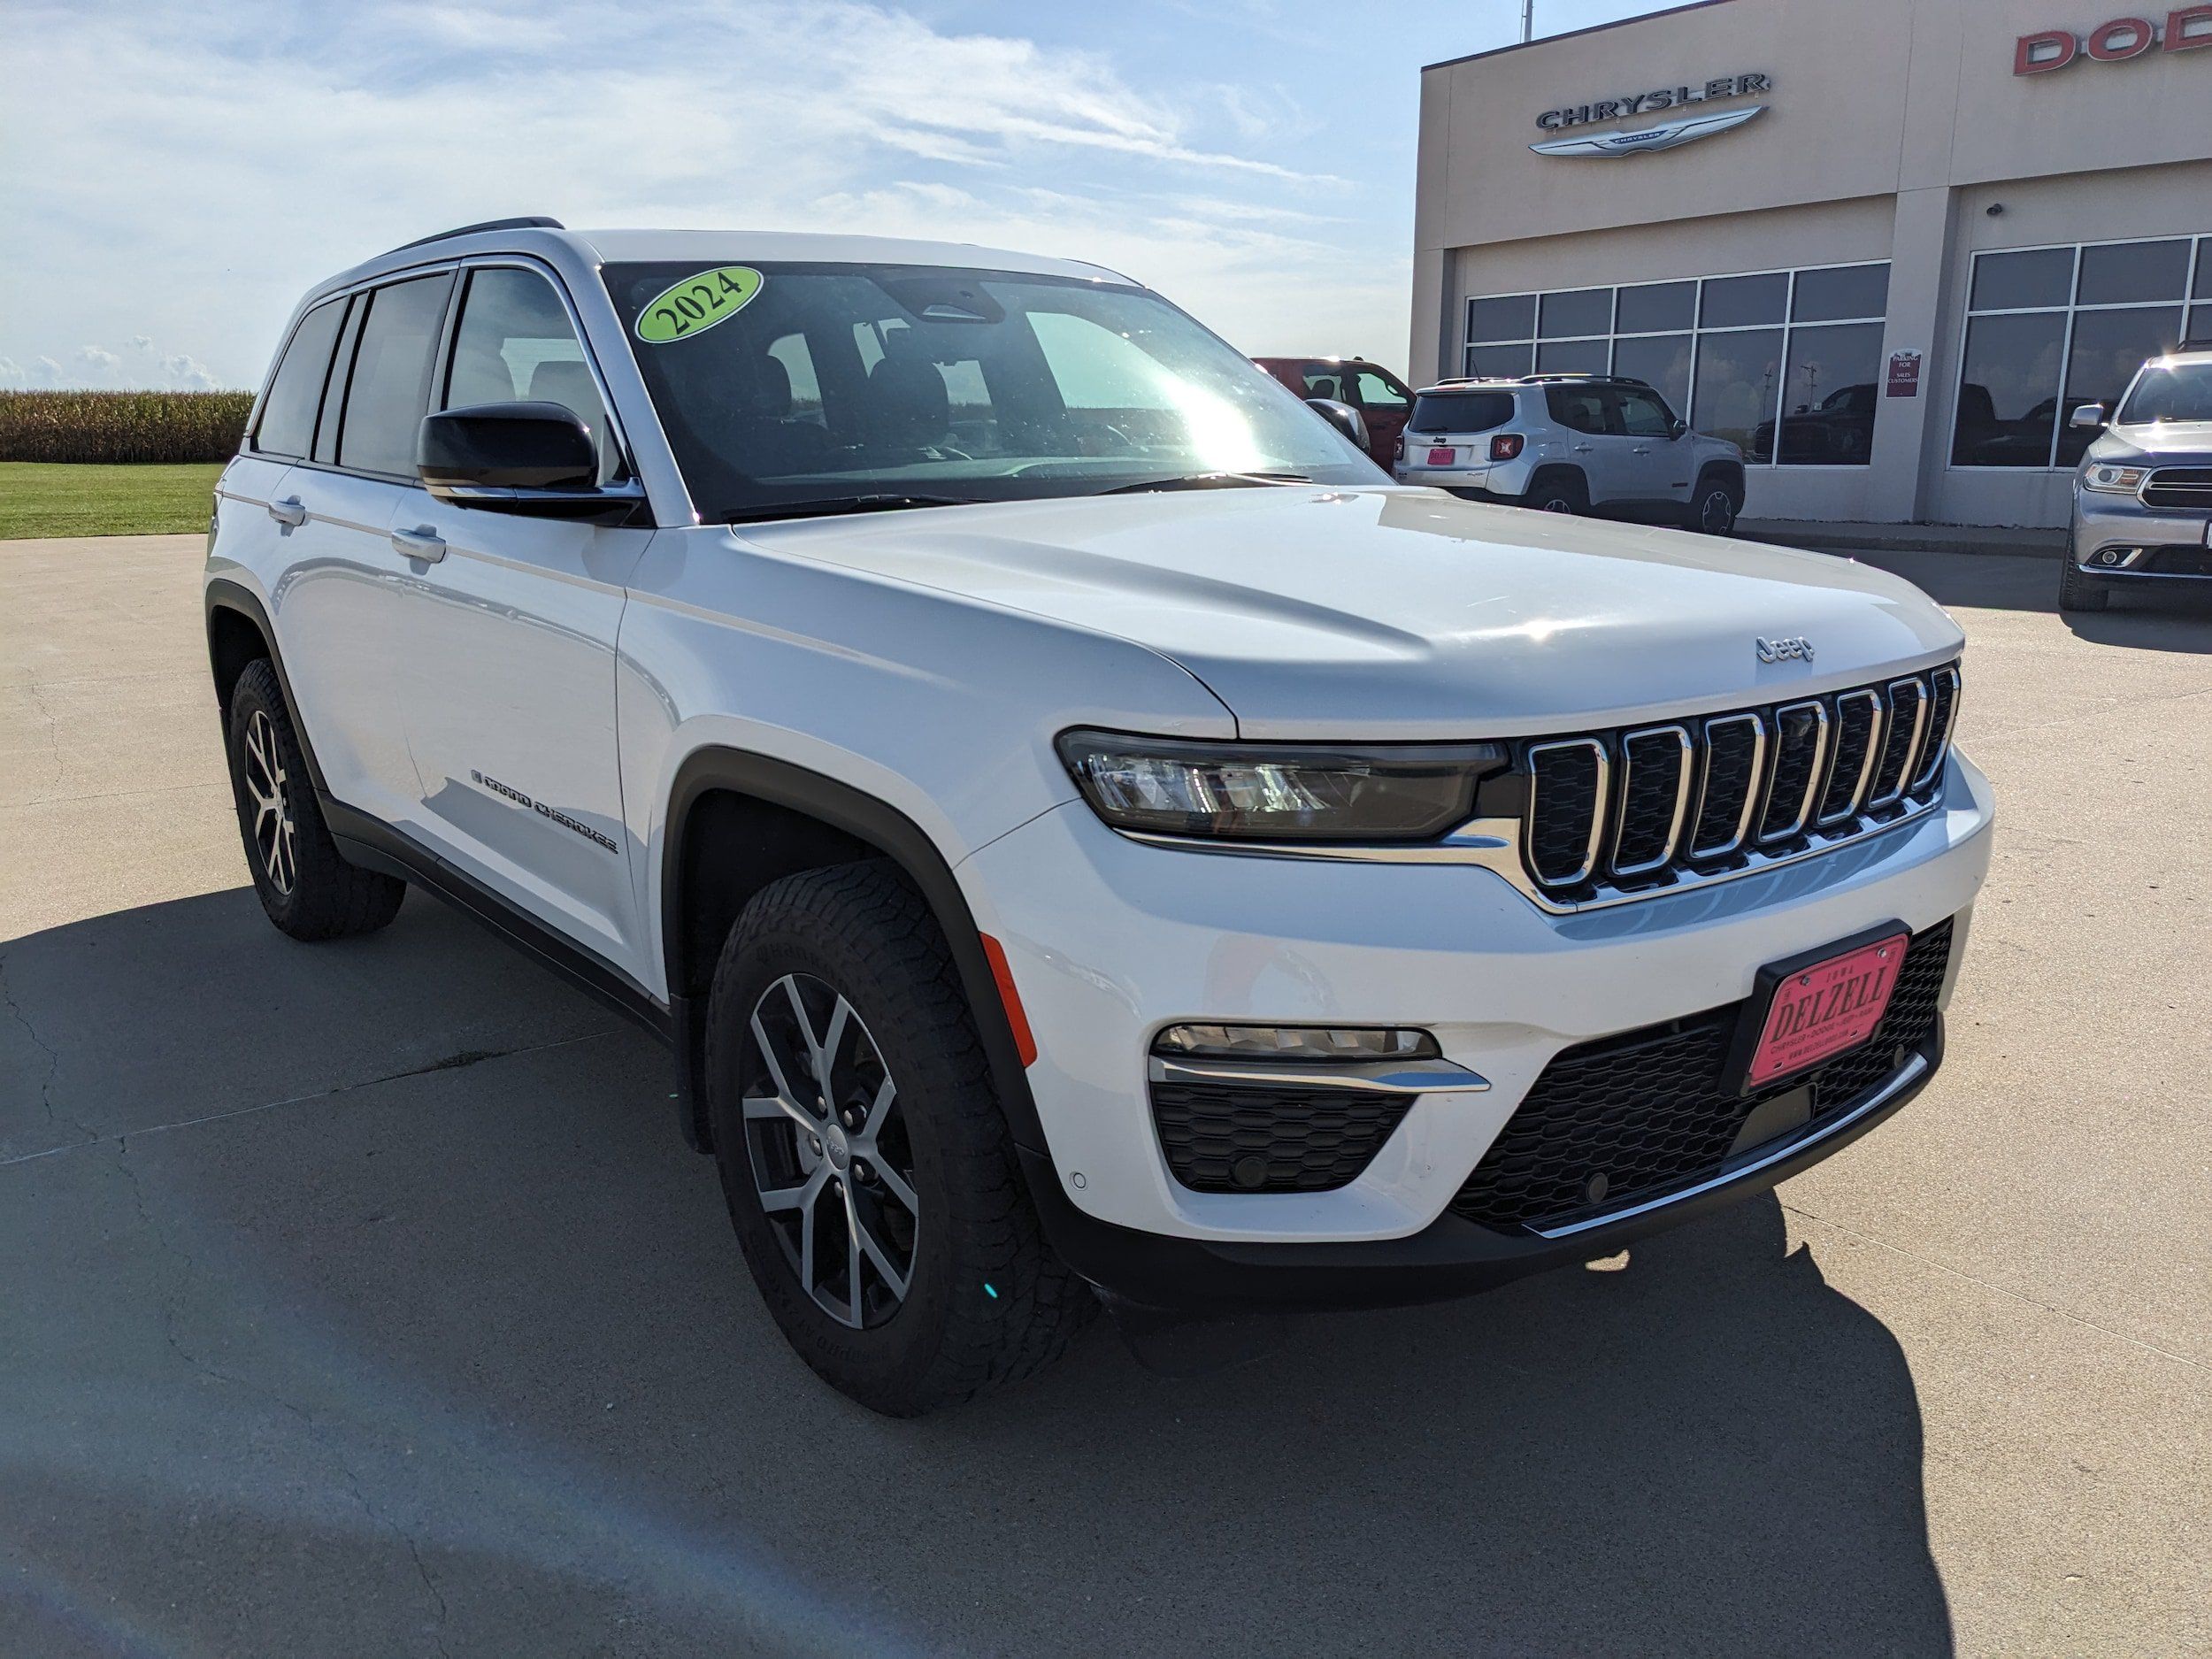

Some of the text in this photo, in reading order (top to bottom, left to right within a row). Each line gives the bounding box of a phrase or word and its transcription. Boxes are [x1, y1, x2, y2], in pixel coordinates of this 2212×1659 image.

[1536, 73, 1768, 130] CHRYSLER
[1615, 133, 1660, 143] CHRYSLER
[656, 272, 743, 334] 2024
[1756, 636, 1815, 664] Jeep
[484, 776, 618, 855] GRAND CHEROKEE
[1770, 966, 1886, 1044] DELZELL
